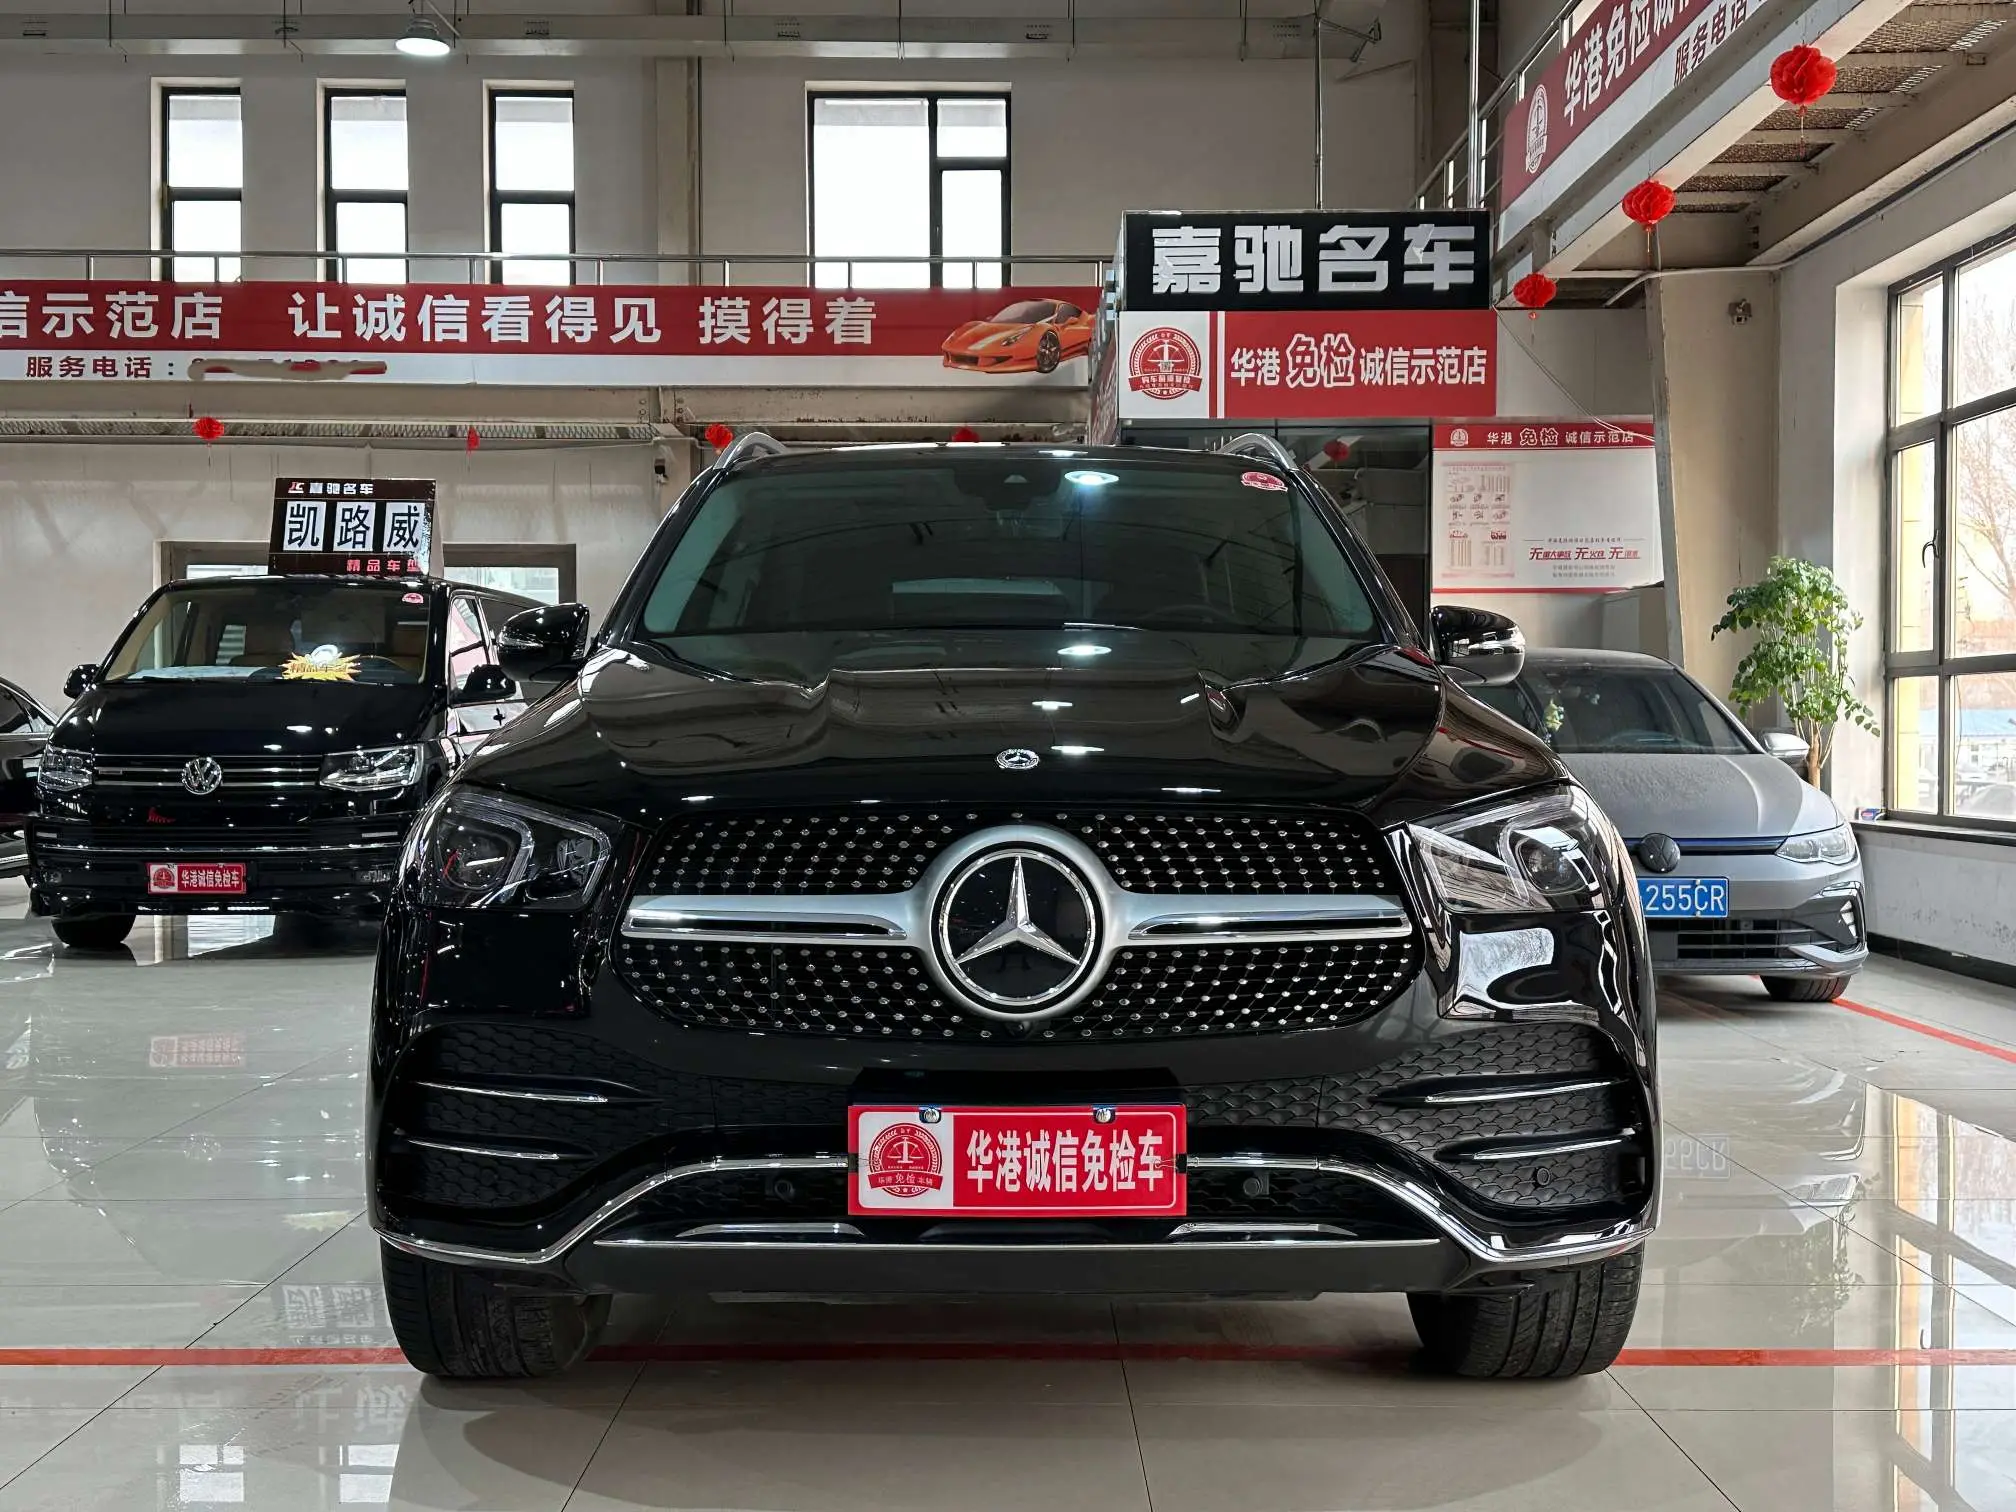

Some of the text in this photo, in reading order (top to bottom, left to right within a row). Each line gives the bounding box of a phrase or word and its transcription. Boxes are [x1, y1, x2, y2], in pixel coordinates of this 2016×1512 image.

[1152, 223, 1475, 294] 嘉驰名车
[287, 292, 662, 345] 让诚信看得见
[698, 296, 877, 345] 摸得着
[1230, 333, 1488, 389] 华港免检诚信示范店
[287, 503, 420, 549] 凯路威
[1645, 885, 1725, 912] 255CR
[966, 1129, 1165, 1193] 华港诚信免检车
